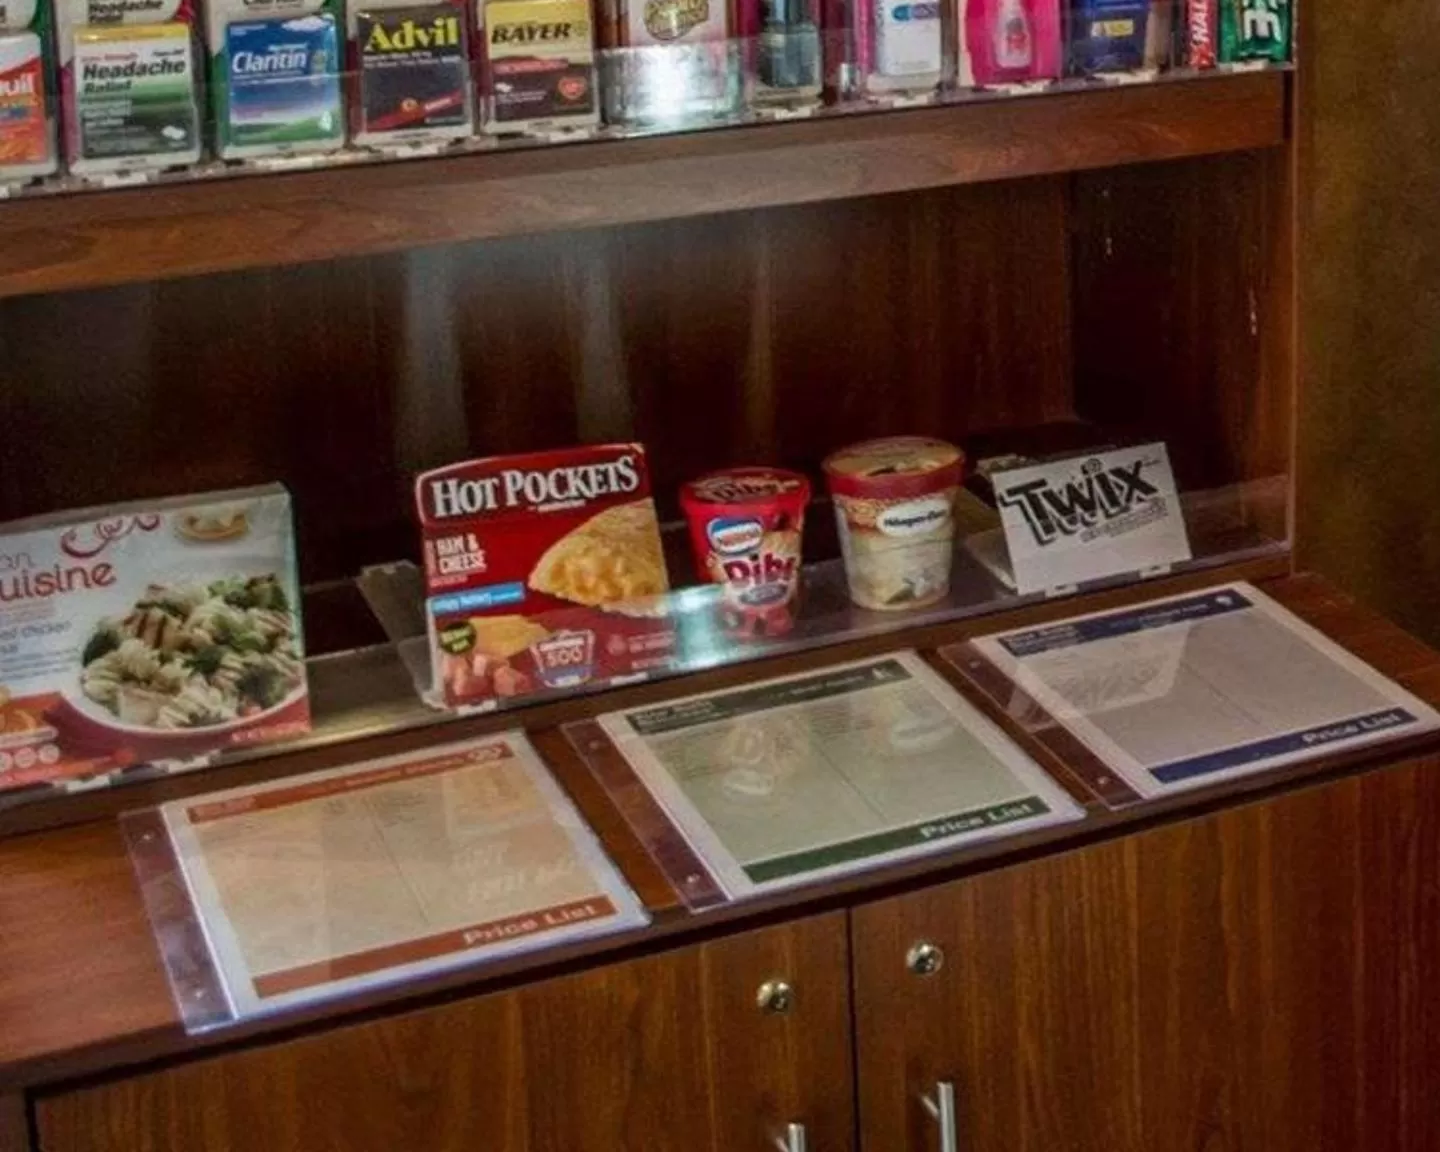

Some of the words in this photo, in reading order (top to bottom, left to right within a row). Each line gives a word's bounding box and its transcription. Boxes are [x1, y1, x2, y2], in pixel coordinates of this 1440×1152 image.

[364, 16, 458, 52] Advil
[491, 22, 573, 45] BAYER
[84, 59, 187, 79] Headache
[231, 51, 307, 74] Claritin
[432, 477, 499, 518] HOT
[502, 456, 639, 507] POCKETS
[1302, 724, 1362, 747] Price
[1361, 712, 1401, 734] List
[920, 813, 985, 840] Price
[987, 803, 1034, 826] List
[463, 913, 542, 947] Price
[544, 902, 600, 929] List
